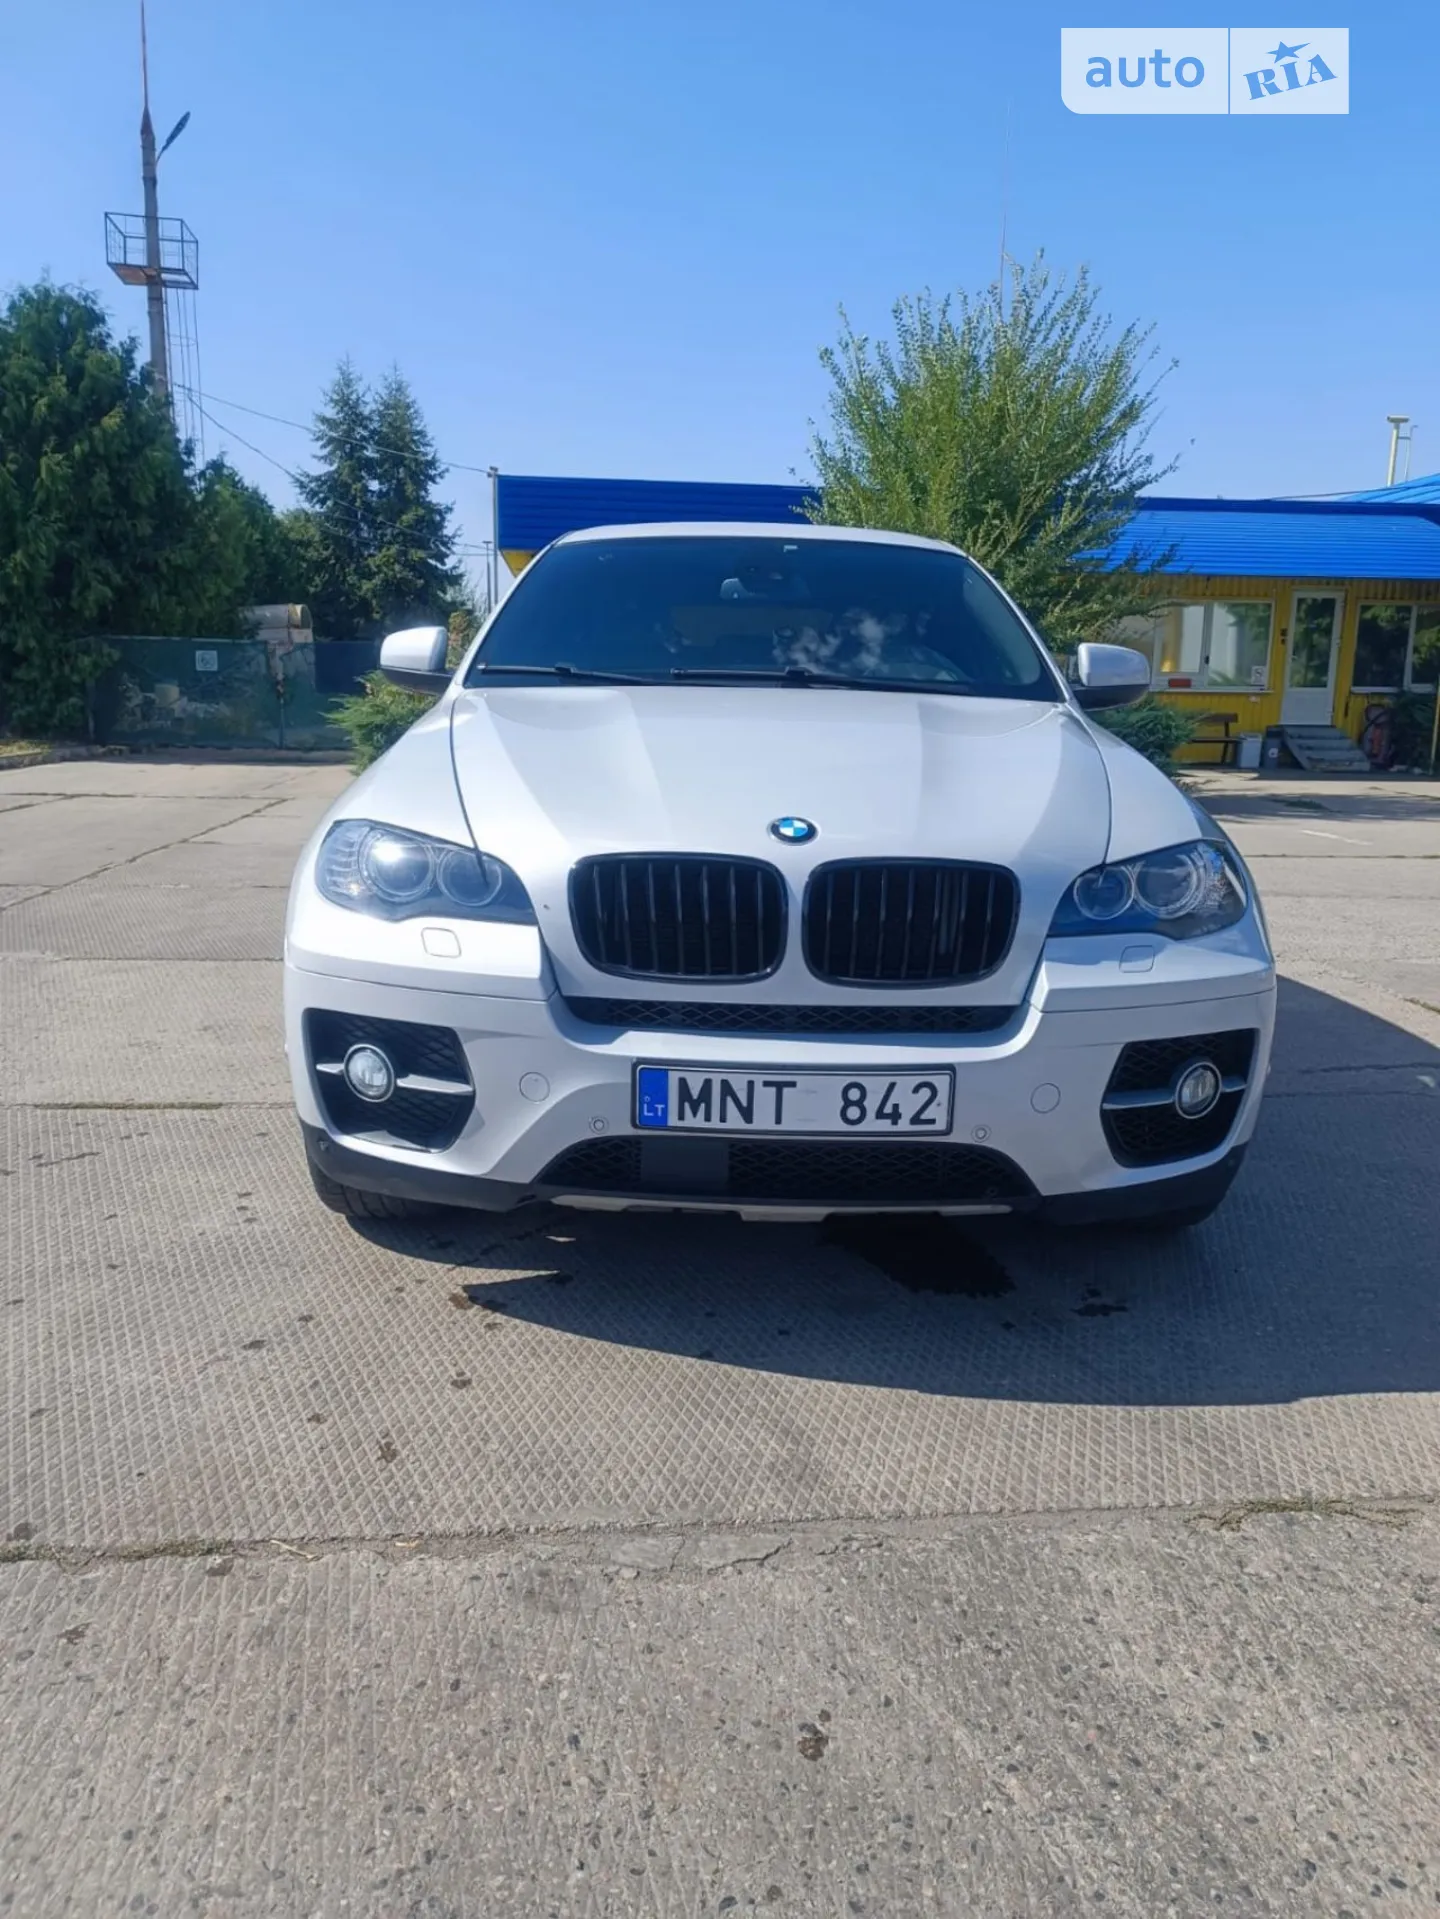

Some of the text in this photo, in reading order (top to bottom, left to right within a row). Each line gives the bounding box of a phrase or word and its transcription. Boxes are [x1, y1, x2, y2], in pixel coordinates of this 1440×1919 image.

[643, 1103, 666, 1118] LT
[677, 1076, 940, 1127] MNT 842
